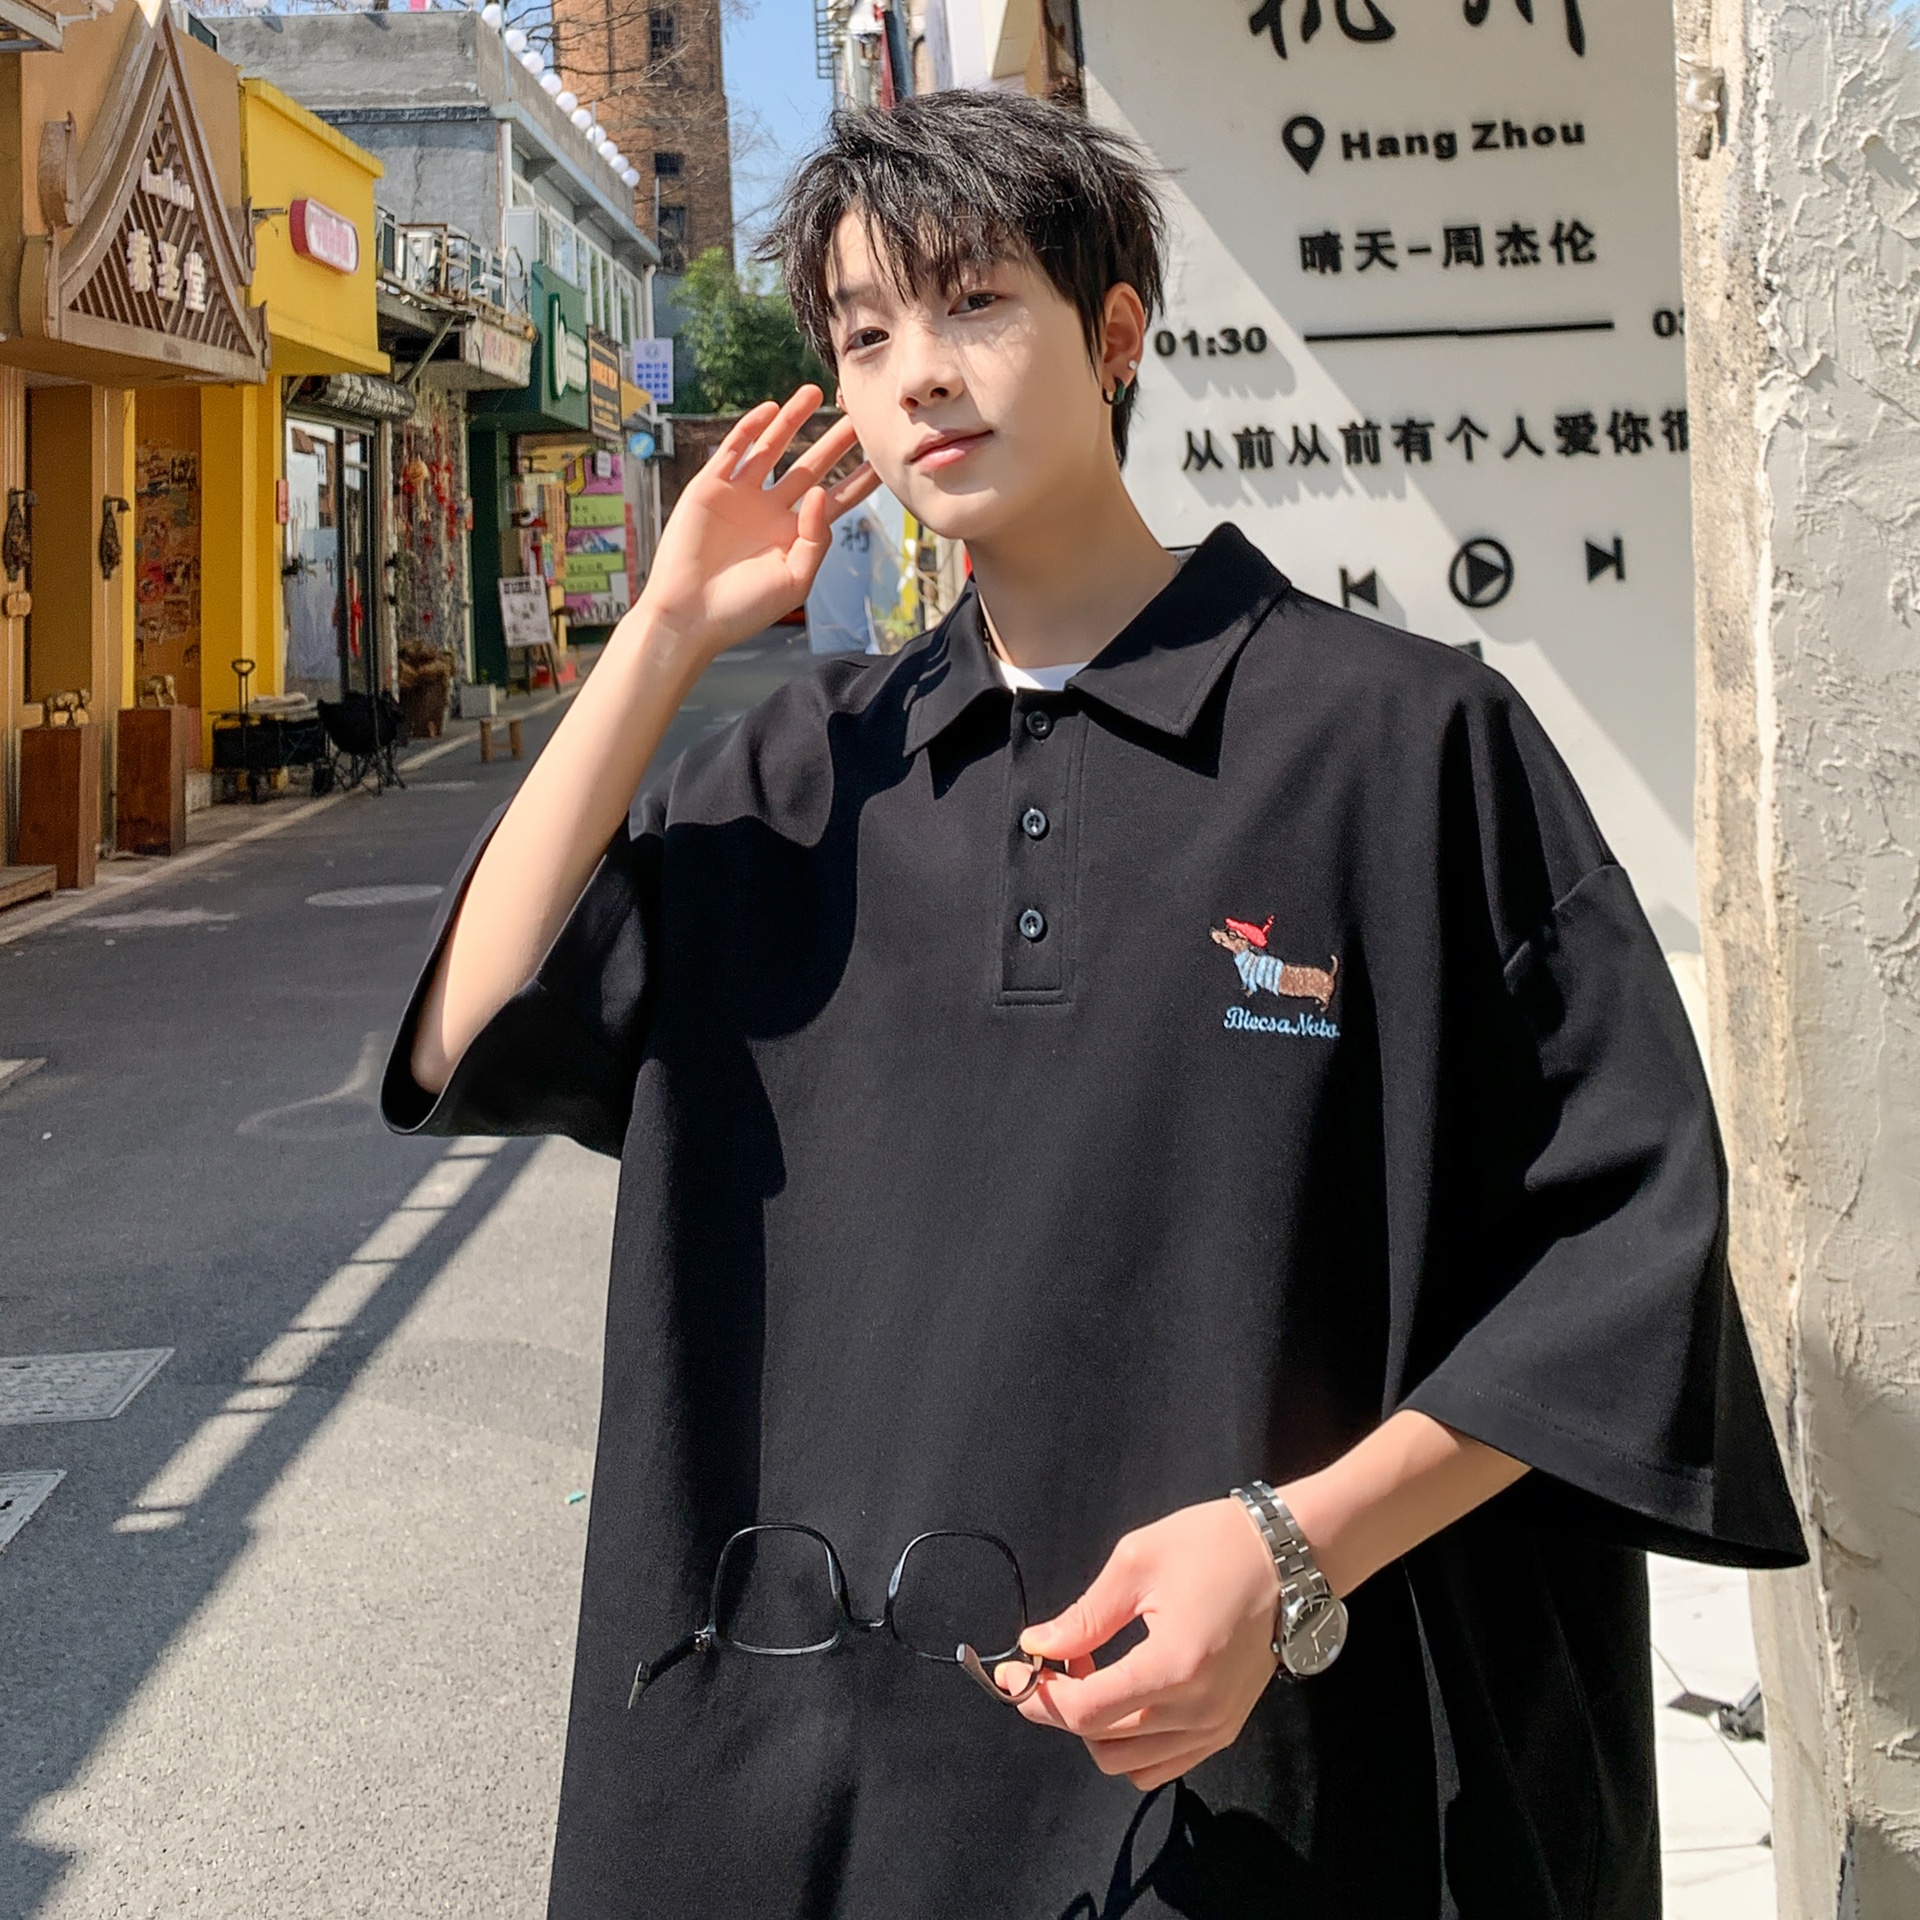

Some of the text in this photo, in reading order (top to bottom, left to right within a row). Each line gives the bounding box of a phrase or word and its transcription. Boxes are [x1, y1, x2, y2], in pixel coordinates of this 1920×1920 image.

[1340, 118, 1586, 162] Hang Zhou
[1154, 325, 1269, 358] 01:30
